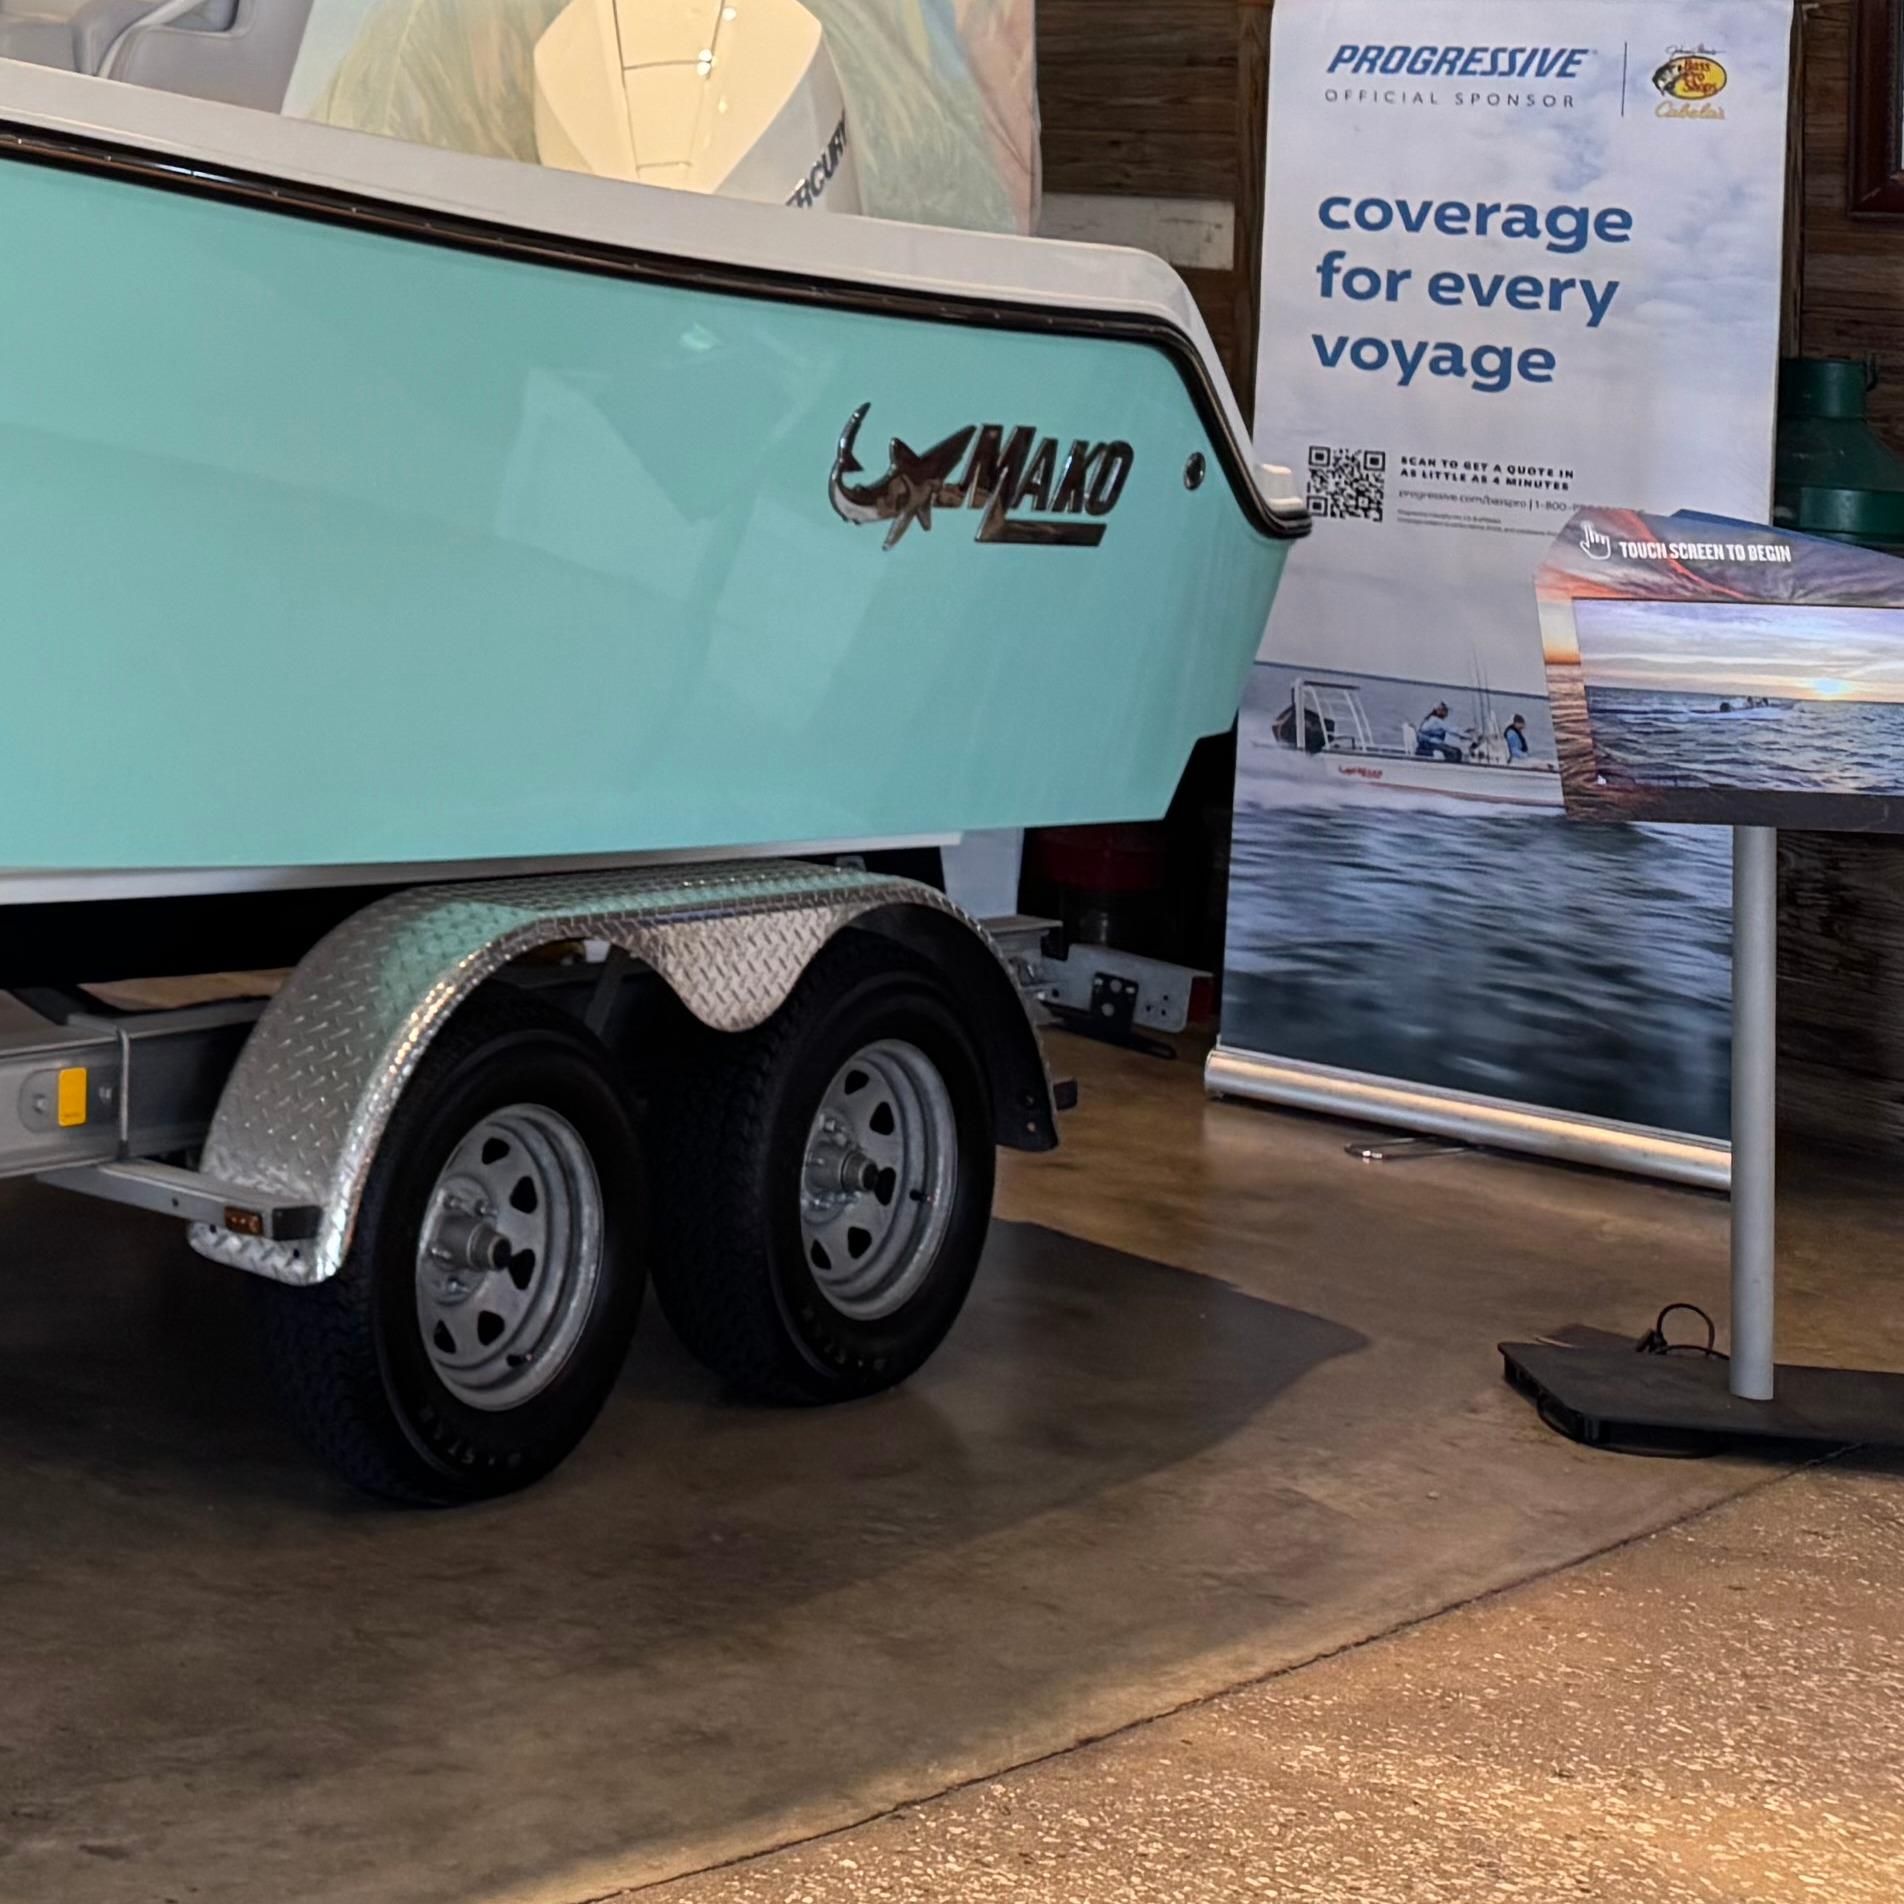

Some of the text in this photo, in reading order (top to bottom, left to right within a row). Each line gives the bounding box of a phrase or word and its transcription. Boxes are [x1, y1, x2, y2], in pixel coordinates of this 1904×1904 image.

[1326, 44, 1588, 78] PROGRESSIVE
[1324, 88, 1574, 108] OFFICIAL SPONSOR
[1318, 196, 1633, 253] coverage
[1316, 250, 1620, 328] for every
[1311, 334, 1556, 393] voyage
[1400, 456, 1574, 479] SCAN TO GET A QUOTE IN
[1422, 470, 1466, 482] LITTLE
[1493, 477, 1500, 486] 4
[1506, 477, 1569, 491] MINUTES
[933, 423, 1135, 547] MAKO
[1618, 541, 1792, 562] TOUCH SCREEN TO BEGIN
